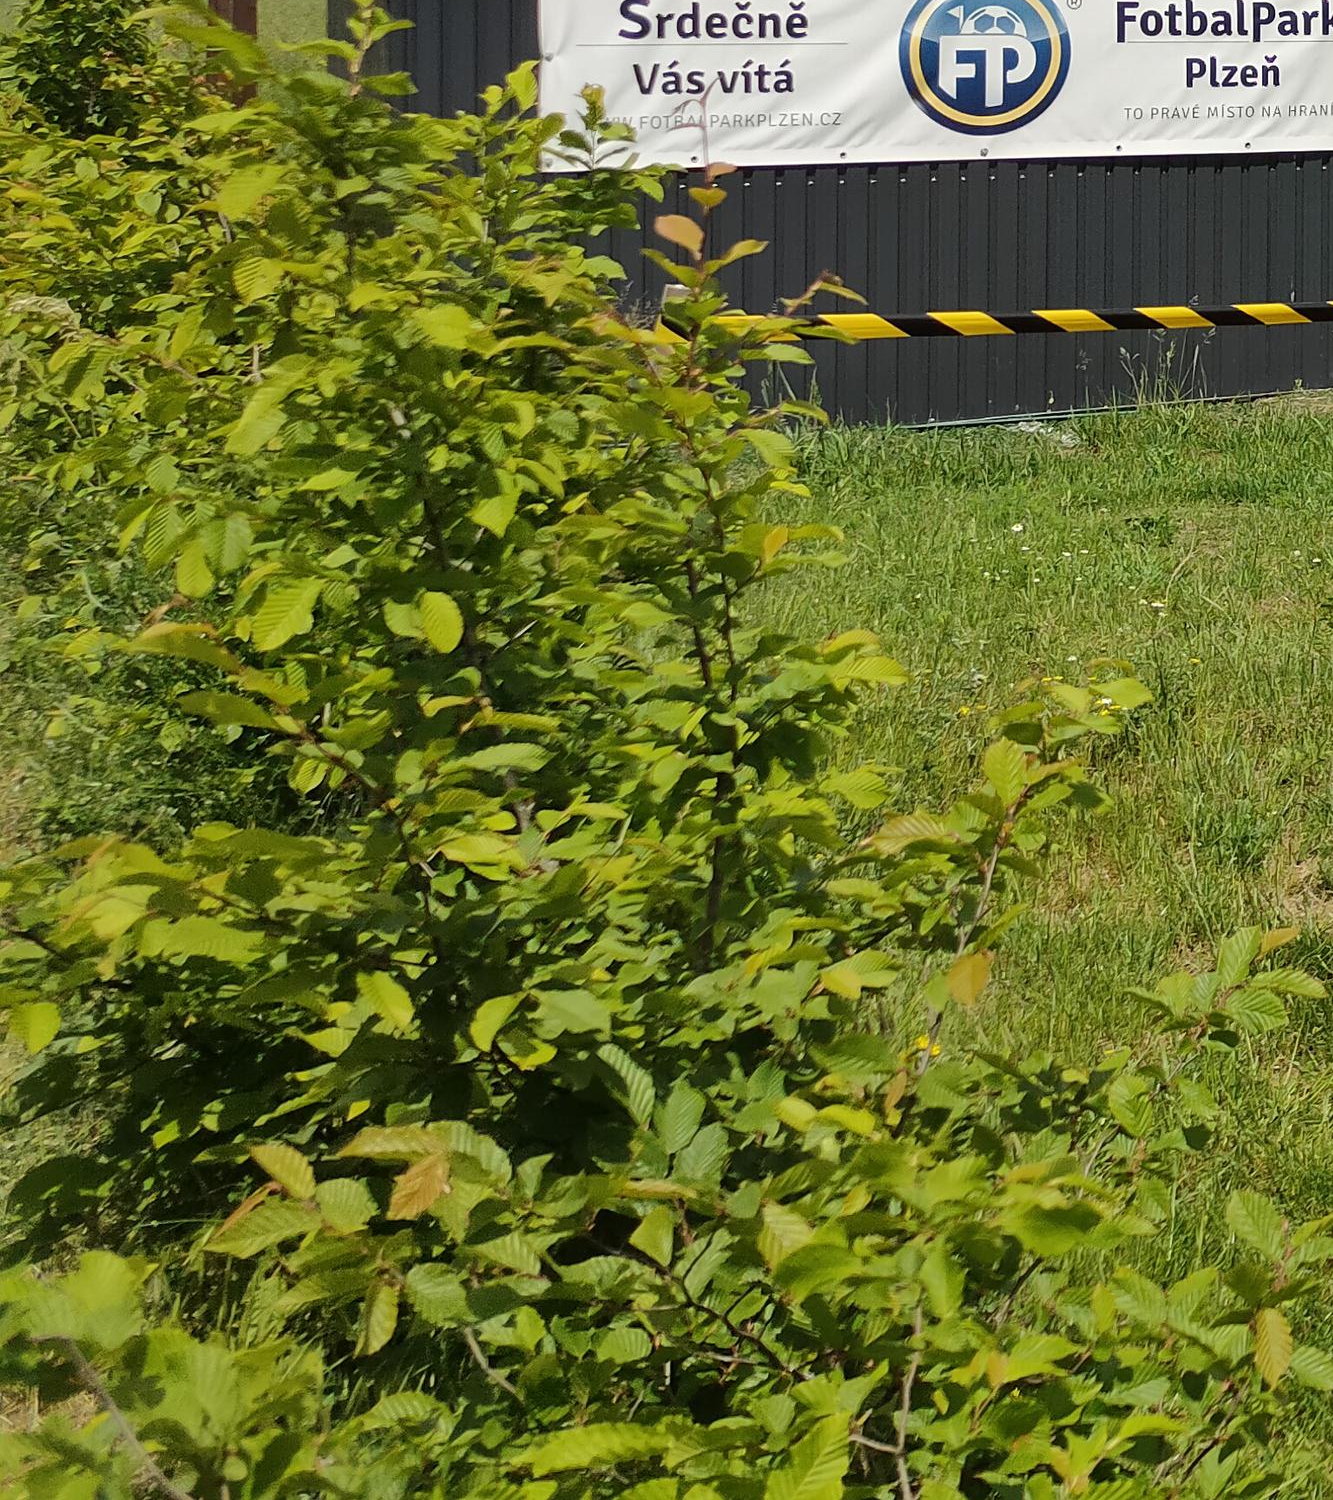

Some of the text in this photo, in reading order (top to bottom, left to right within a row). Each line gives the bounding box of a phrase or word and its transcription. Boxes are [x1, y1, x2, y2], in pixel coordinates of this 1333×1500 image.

[632, 59, 795, 95] Vás vítá
[1186, 54, 1280, 88] Plzeň
[1124, 107, 1143, 120] TO
[1151, 104, 1200, 120] PRAVÉ
[1207, 102, 1255, 119] MÍSTO
[1261, 105, 1282, 118] NA
